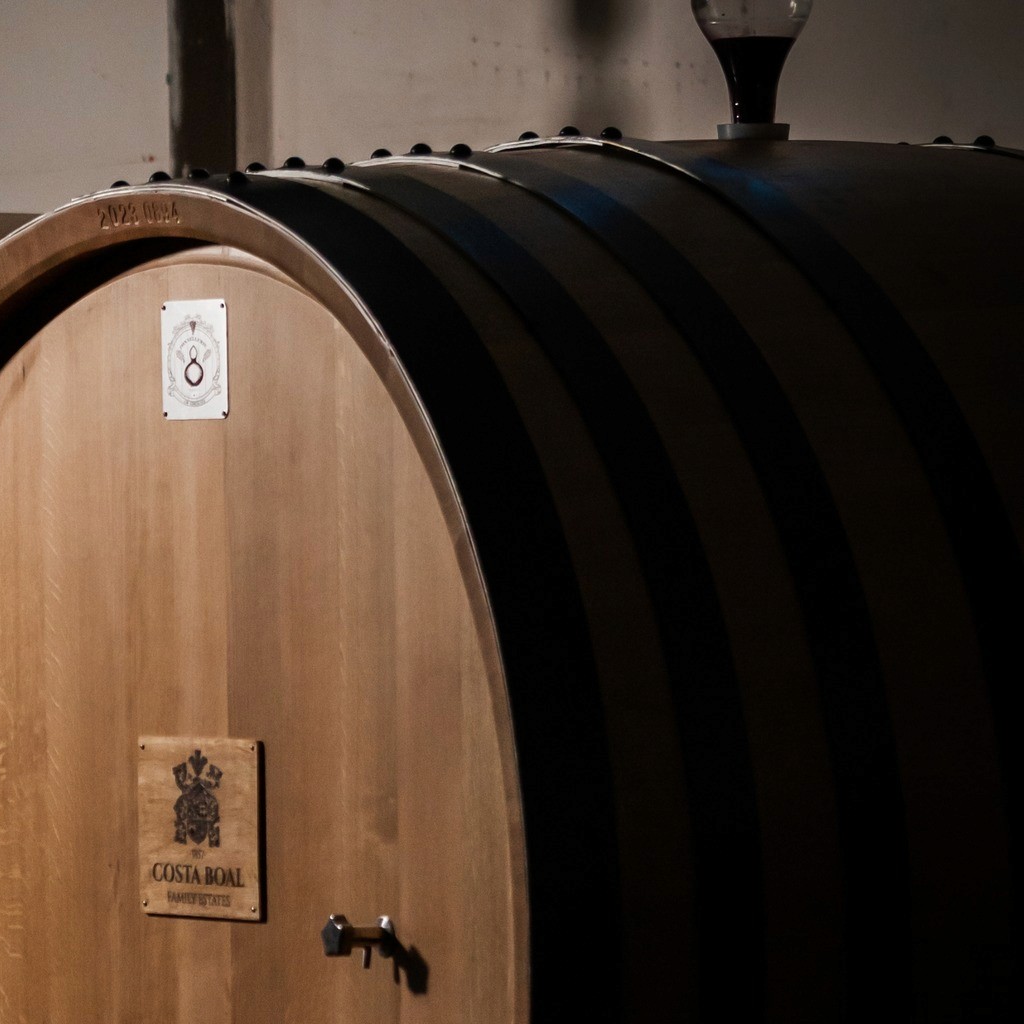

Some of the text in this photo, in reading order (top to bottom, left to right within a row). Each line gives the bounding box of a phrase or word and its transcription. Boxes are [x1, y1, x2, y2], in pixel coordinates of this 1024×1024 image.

[97, 202, 139, 230] 2023
[152, 862, 245, 888] COSTA BOAL
[167, 891, 231, 908] FAMILY ESTATES
